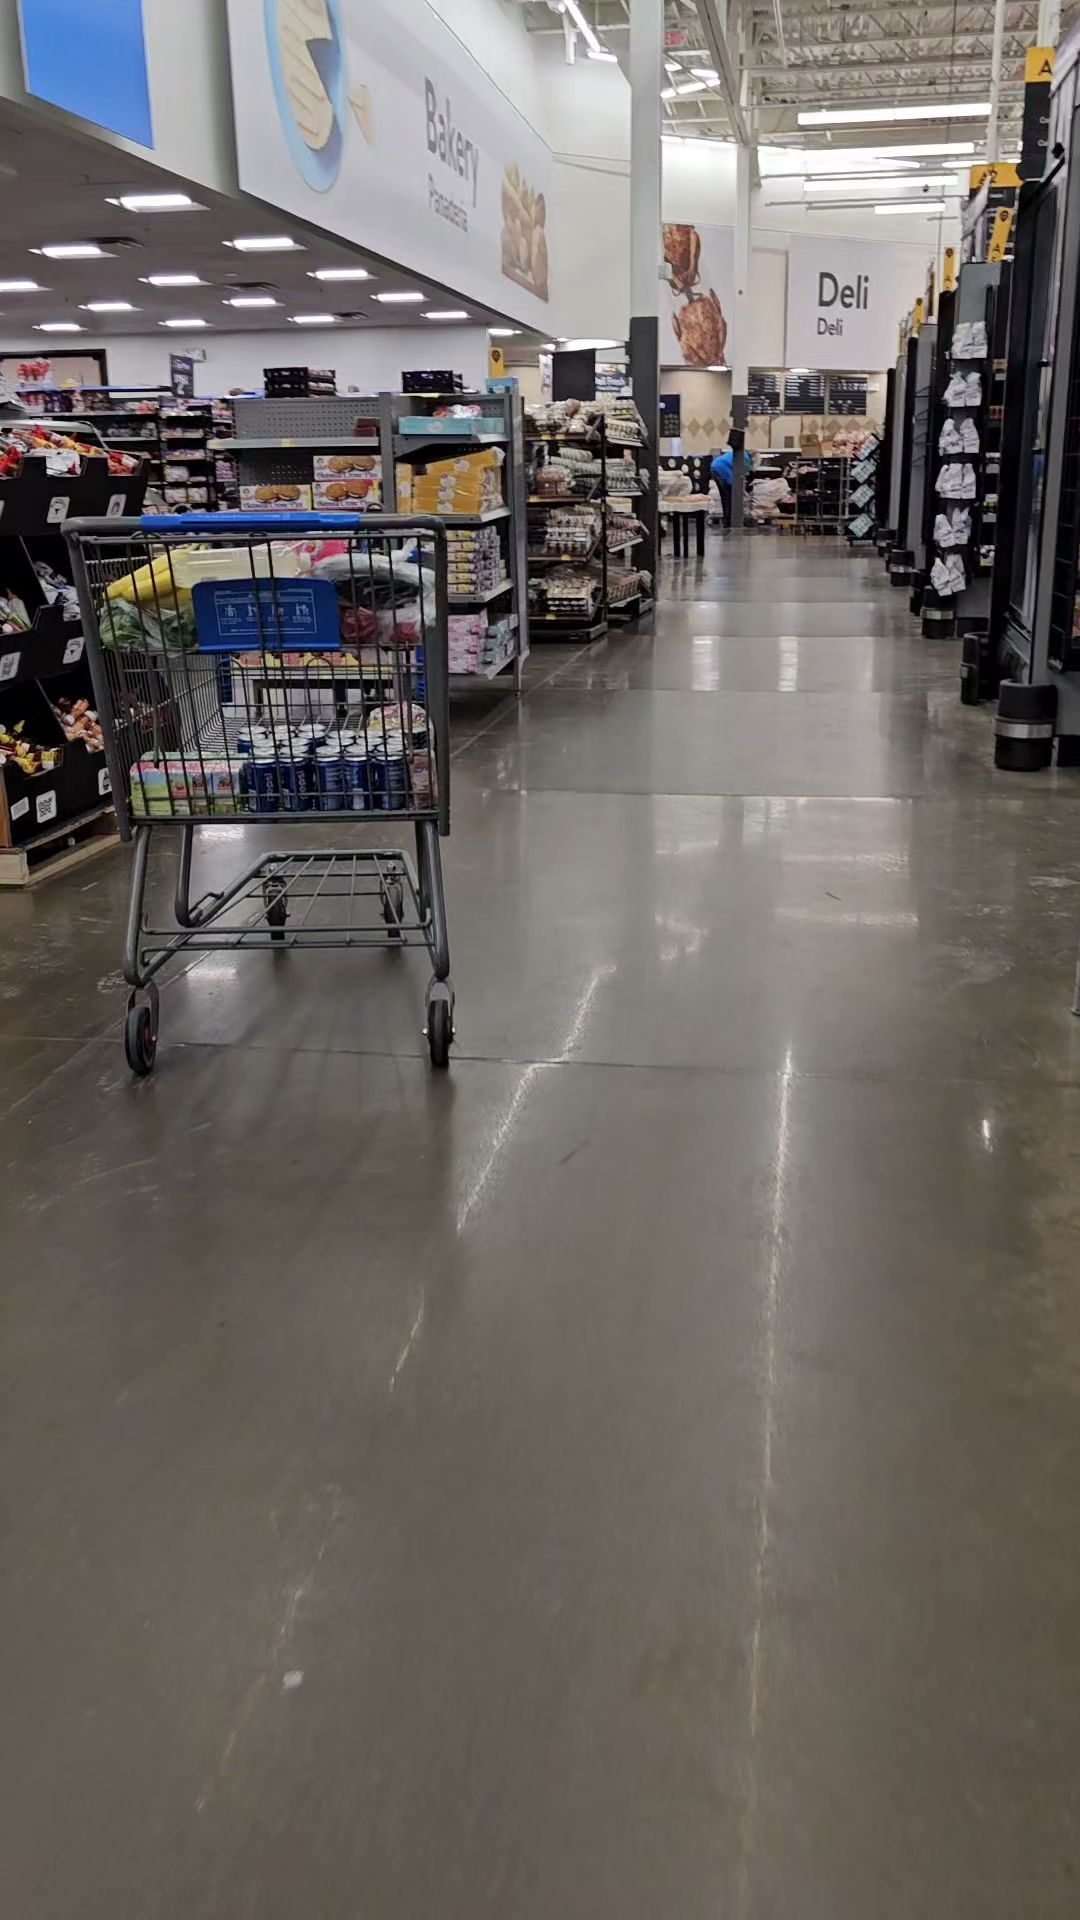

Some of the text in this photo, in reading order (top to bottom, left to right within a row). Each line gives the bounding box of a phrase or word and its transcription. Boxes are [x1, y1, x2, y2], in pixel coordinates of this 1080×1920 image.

[425, 76, 479, 208] Bakery
[818, 271, 869, 310] Deli
[817, 317, 843, 336] Deli
[264, 772, 274, 802] pepsi
[296, 770, 308, 800] pepsi
